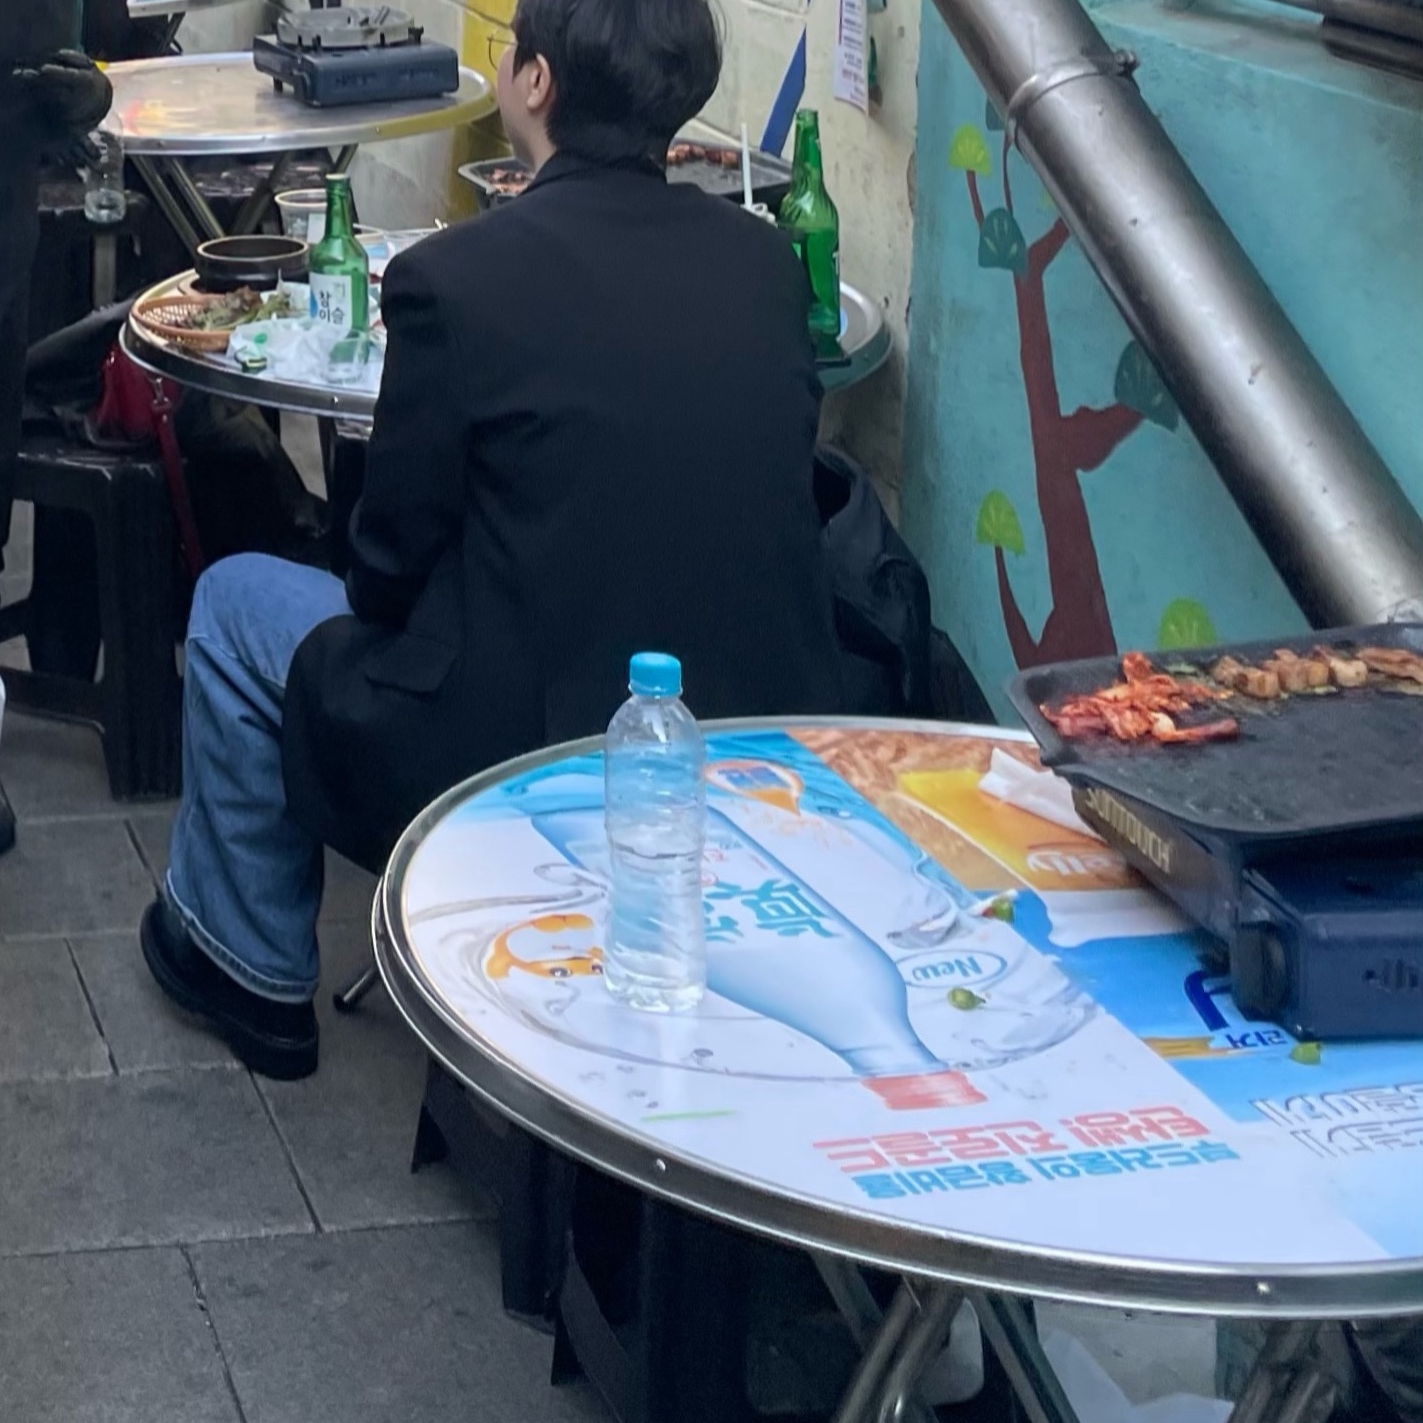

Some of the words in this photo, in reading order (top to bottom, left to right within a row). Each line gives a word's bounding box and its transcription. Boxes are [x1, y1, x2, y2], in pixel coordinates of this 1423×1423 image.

[1027, 849, 1112, 876] elly
[912, 955, 983, 982] New
[812, 1120, 1069, 1173] 진로골드
[1059, 1106, 1212, 1147] 탄생!
[1026, 1141, 1241, 1181] 부드러움의
